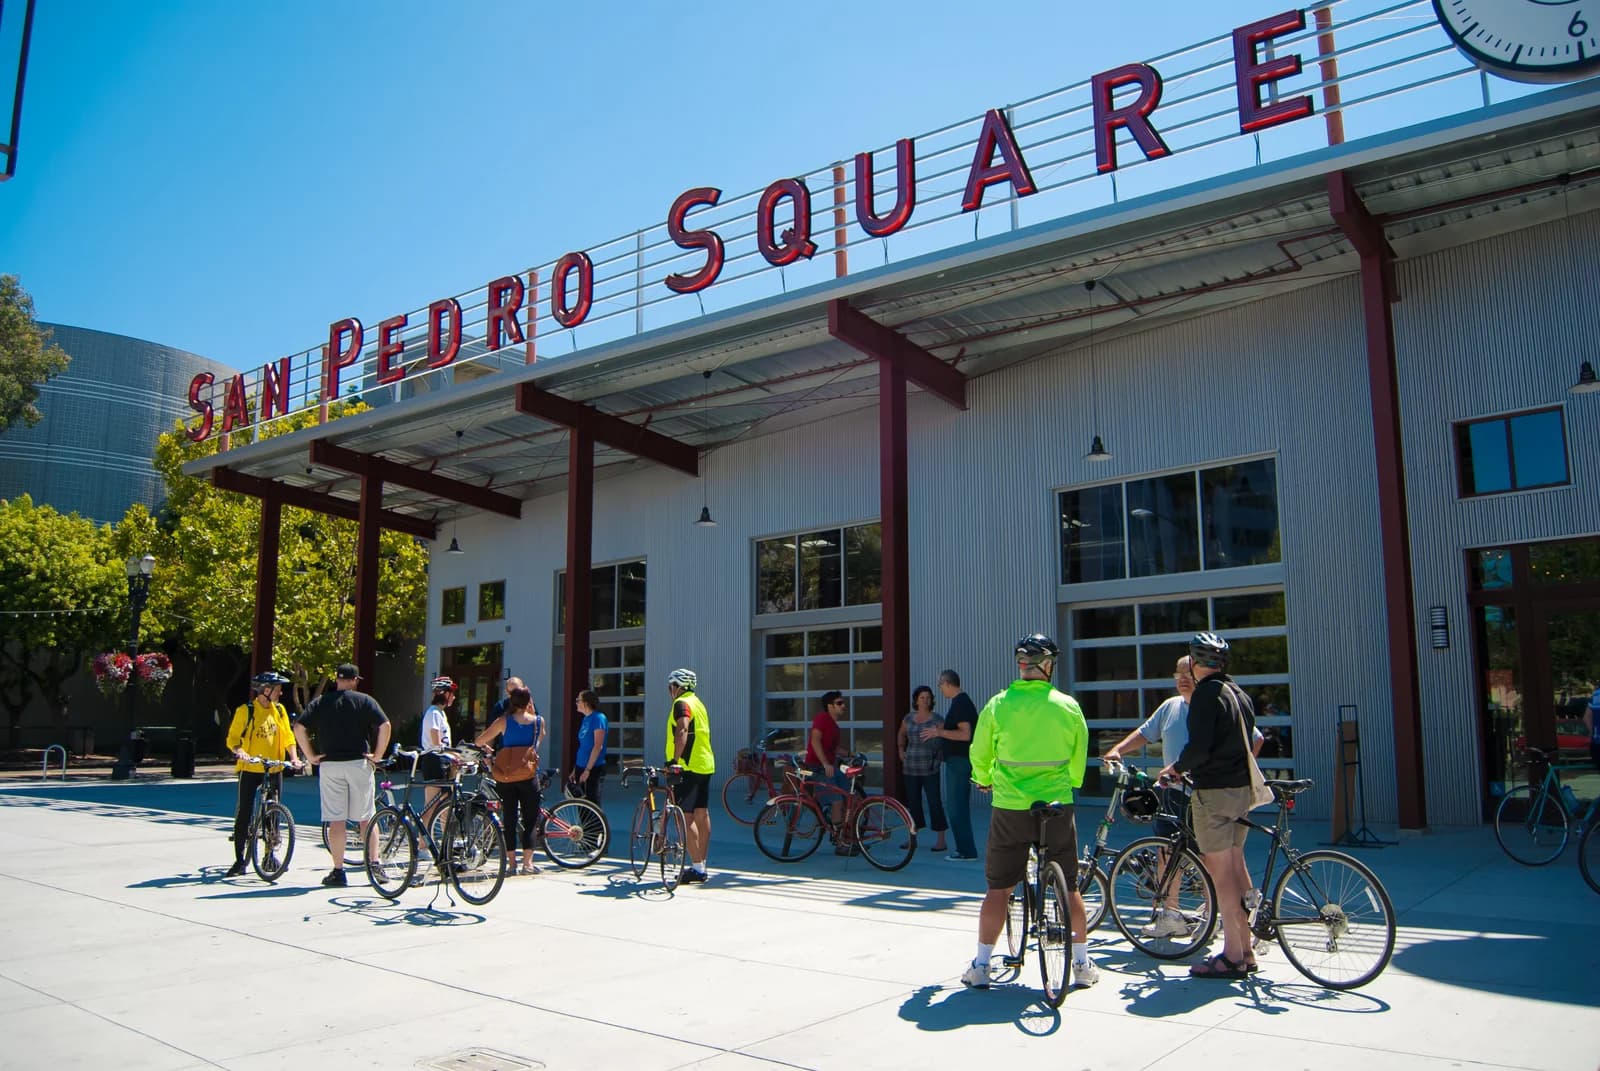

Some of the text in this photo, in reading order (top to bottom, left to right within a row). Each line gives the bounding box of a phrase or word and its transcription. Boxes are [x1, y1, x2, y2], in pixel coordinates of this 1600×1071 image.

[1568, 10, 1588, 37] 6
[185, 9, 1313, 442] SAN PEDRO SQUARE
